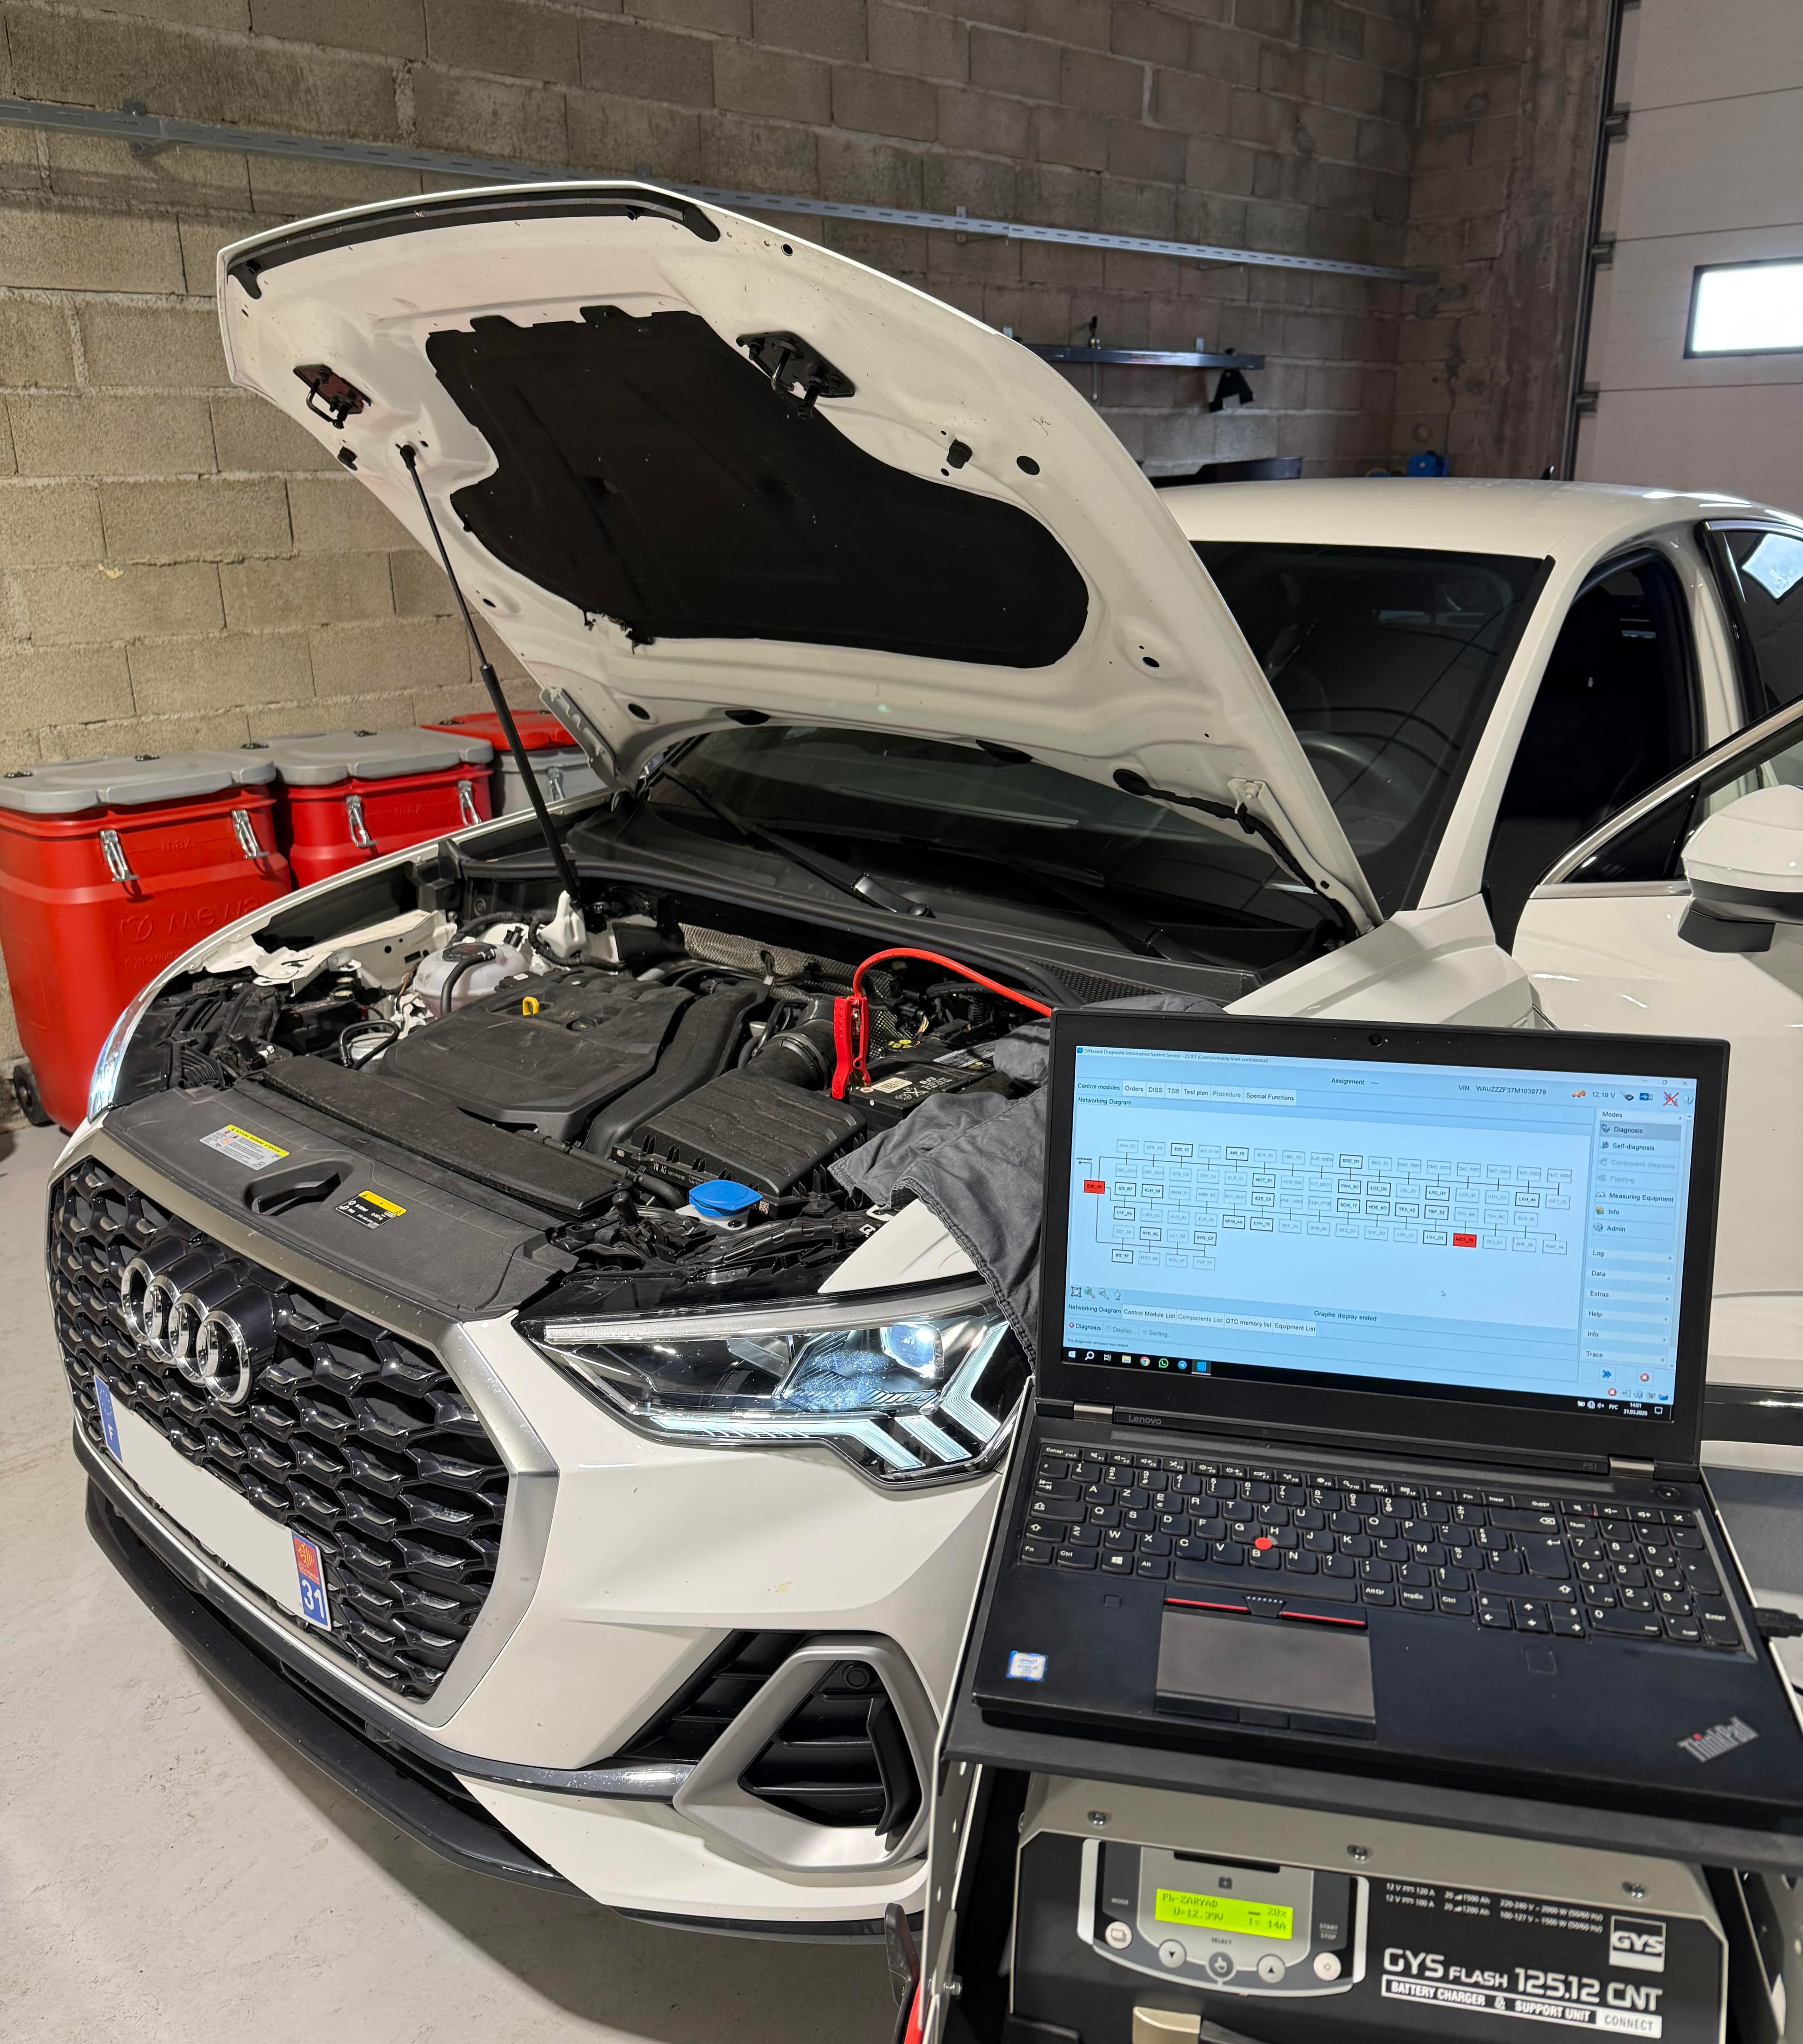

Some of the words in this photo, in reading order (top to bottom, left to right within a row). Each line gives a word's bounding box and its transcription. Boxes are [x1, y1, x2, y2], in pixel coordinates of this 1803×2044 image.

[1476, 1086, 1546, 1095] WAUZZZF37M1039779
[660, 1165, 667, 1174] AG
[1610, 1176, 1635, 1184] Flashing
[1609, 1192, 1641, 1201] Measuring
[1128, 1414, 1162, 1426] Lenovo
[108, 1424, 114, 1440] F
[1109, 1530, 1121, 1538] W
[1144, 1534, 1153, 1543] X
[1417, 1544, 1427, 1553] M
[301, 1579, 325, 1619] 31
[1676, 1716, 1759, 1763] ThinkPad
[1111, 1897, 1129, 1906] MODE
[1162, 1893, 1218, 1908] Pb-ZARYAD
[1174, 1906, 1224, 1921] U=12.39V
[1319, 1922, 1339, 1931] START
[1612, 1932, 1664, 1955] GYS
[1383, 1947, 1445, 1979] GYS
[1449, 1967, 1508, 1989] FLASH
[1515, 1967, 1600, 2003] 125.12
[1607, 1982, 1663, 2011] CNT
[1391, 1981, 1436, 1998] BATTERY
[1437, 1987, 1486, 2006] CHARGER
[1494, 1996, 1506, 2011] &
[1514, 1999, 1564, 2019] SUPPORT
[1564, 2006, 1590, 2022] UNIT
[1604, 2014, 1653, 2032] CONNECT
